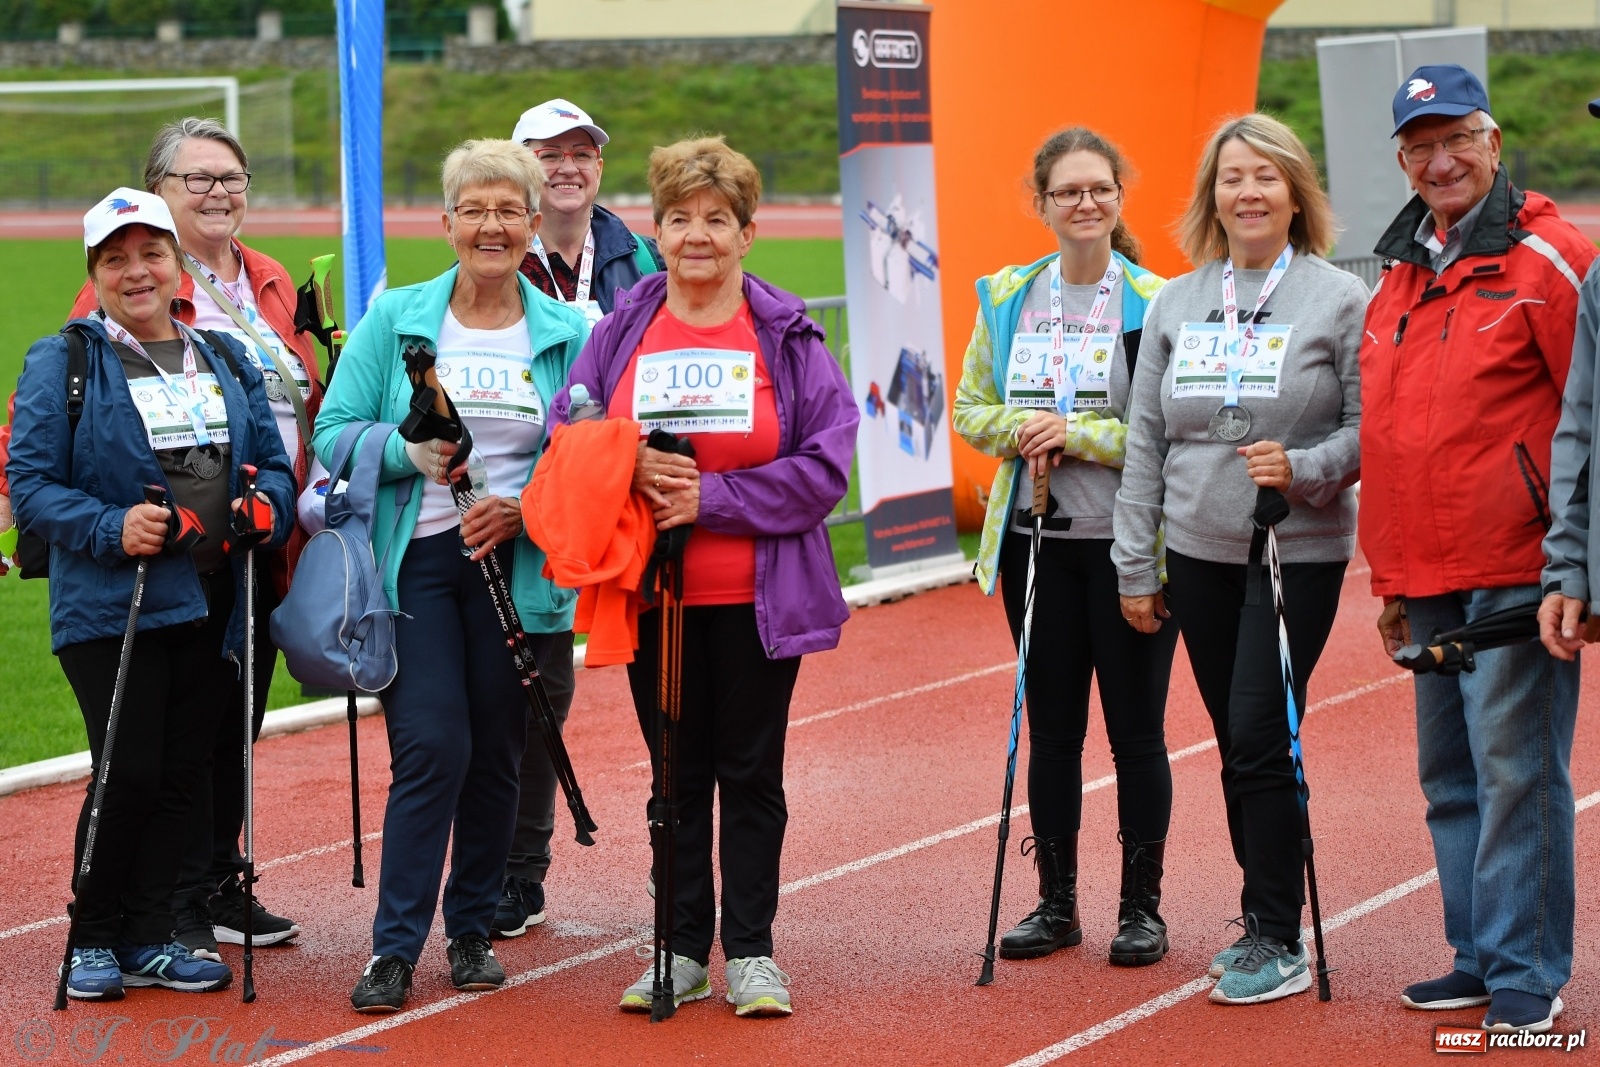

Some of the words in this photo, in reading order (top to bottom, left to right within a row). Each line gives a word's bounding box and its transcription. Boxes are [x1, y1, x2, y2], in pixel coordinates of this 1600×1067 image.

[1205, 310, 1272, 324] NKE
[460, 366, 513, 391] 101
[667, 364, 723, 389] 100
[135, 583, 144, 607] viking
[488, 584, 508, 631] WALKING
[499, 578, 519, 625] WALKING
[102, 761, 111, 784] viking
